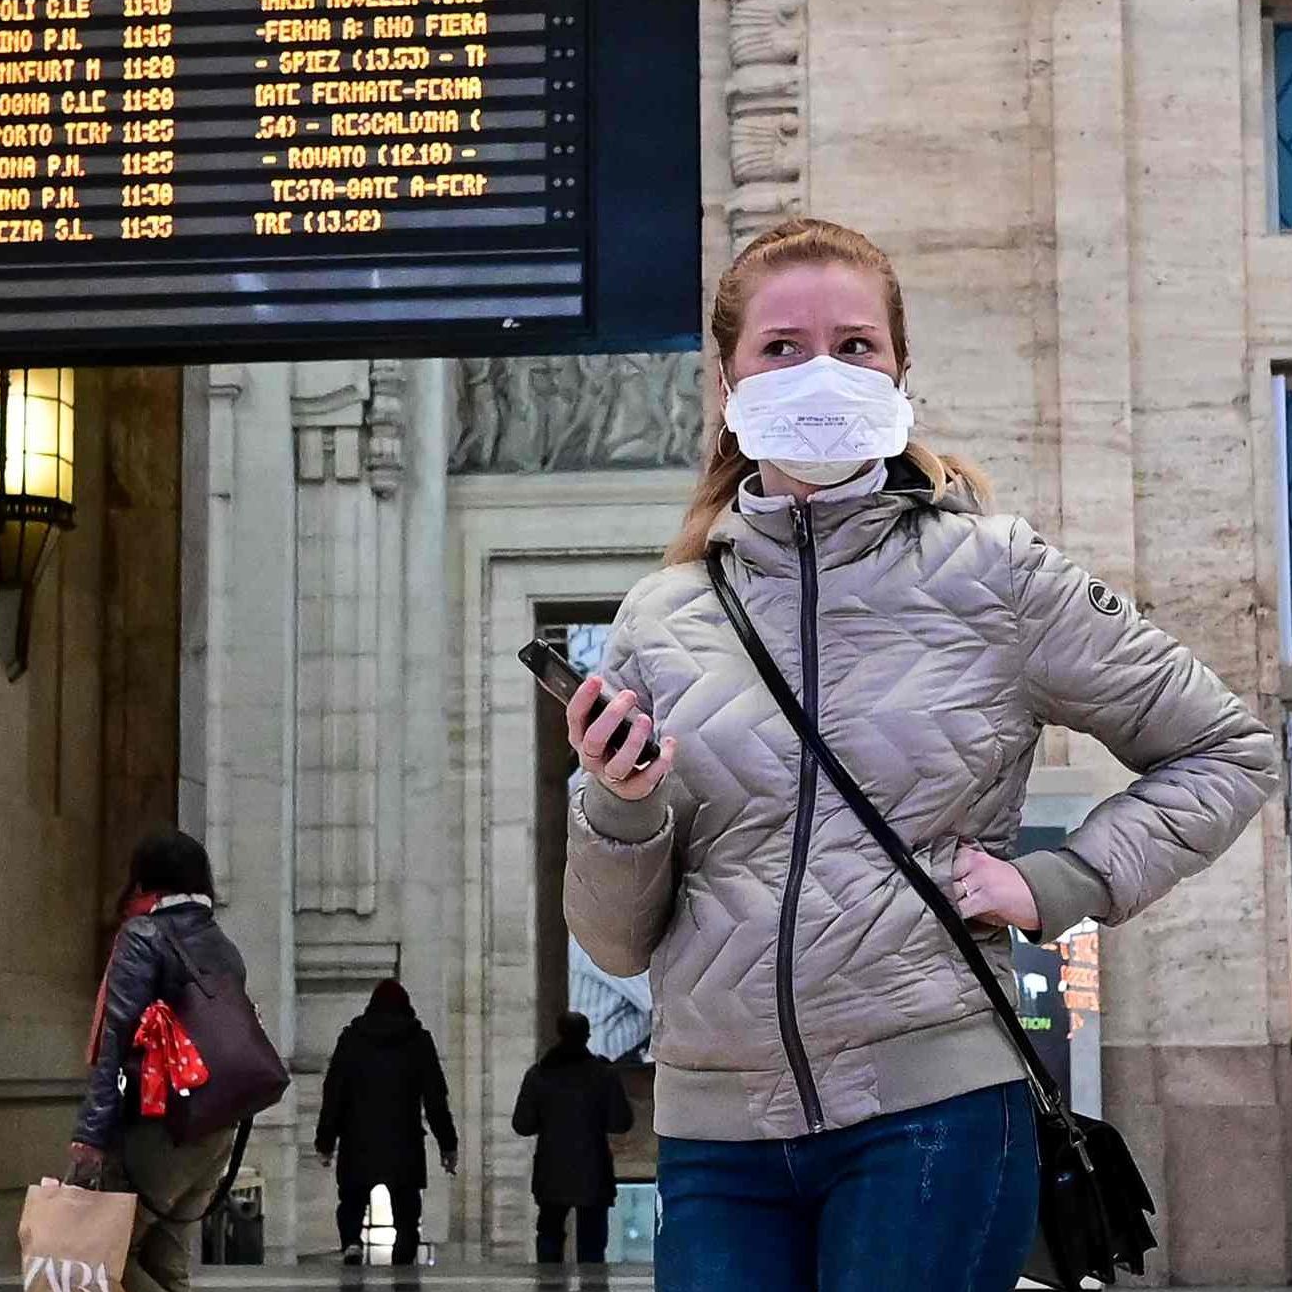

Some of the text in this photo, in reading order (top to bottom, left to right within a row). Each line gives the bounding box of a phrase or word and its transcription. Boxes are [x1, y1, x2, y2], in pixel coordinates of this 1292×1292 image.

[124, 24, 171, 48] 11:15
[374, 16, 413, 38] RHO
[426, 13, 487, 36] FIERA
[44, 28, 82, 51] P.N.
[124, 56, 174, 79] 11:20
[279, 50, 340, 73] SPIEZ
[123, 88, 174, 111] 11:20
[288, 146, 366, 169] ROVATO
[42, 187, 79, 208] P.N.
